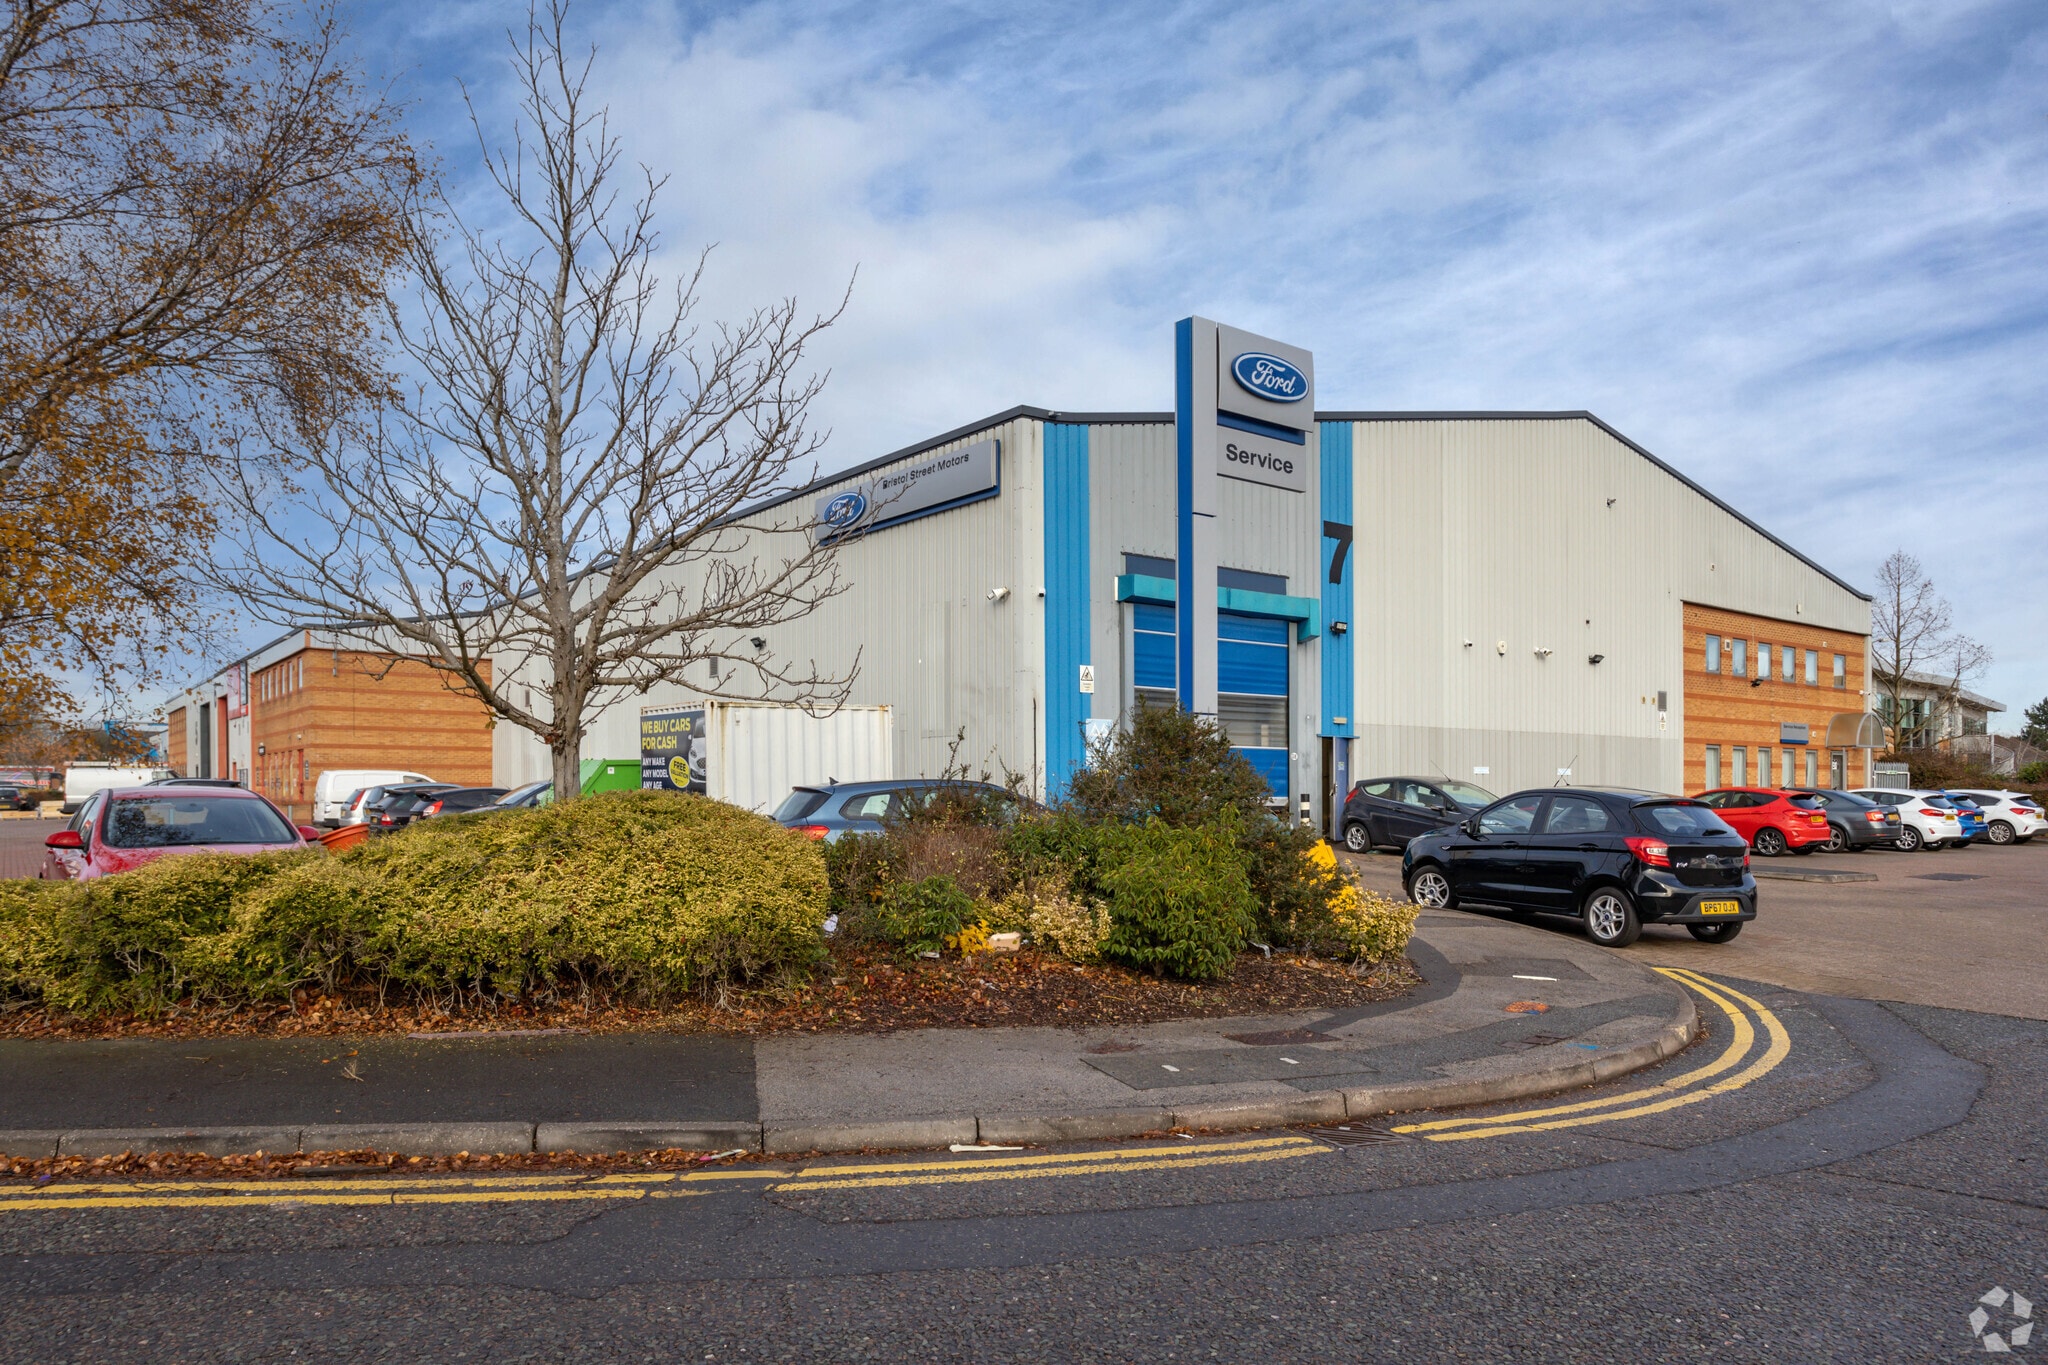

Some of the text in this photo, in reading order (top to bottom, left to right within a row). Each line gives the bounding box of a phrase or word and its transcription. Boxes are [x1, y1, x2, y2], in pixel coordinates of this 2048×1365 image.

[1251, 360, 1296, 394] Ford
[1226, 443, 1294, 474] Service
[882, 453, 970, 490] Bristol Street Motors
[1323, 520, 1353, 584] 7
[641, 717, 691, 734] WE BUY CARS
[641, 735, 677, 750] FOR CASH
[642, 769, 669, 778] ANY MODEL
[673, 760, 687, 772] FREE
[643, 781, 663, 789] ANY AGE
[1703, 902, 1722, 913] BP67
